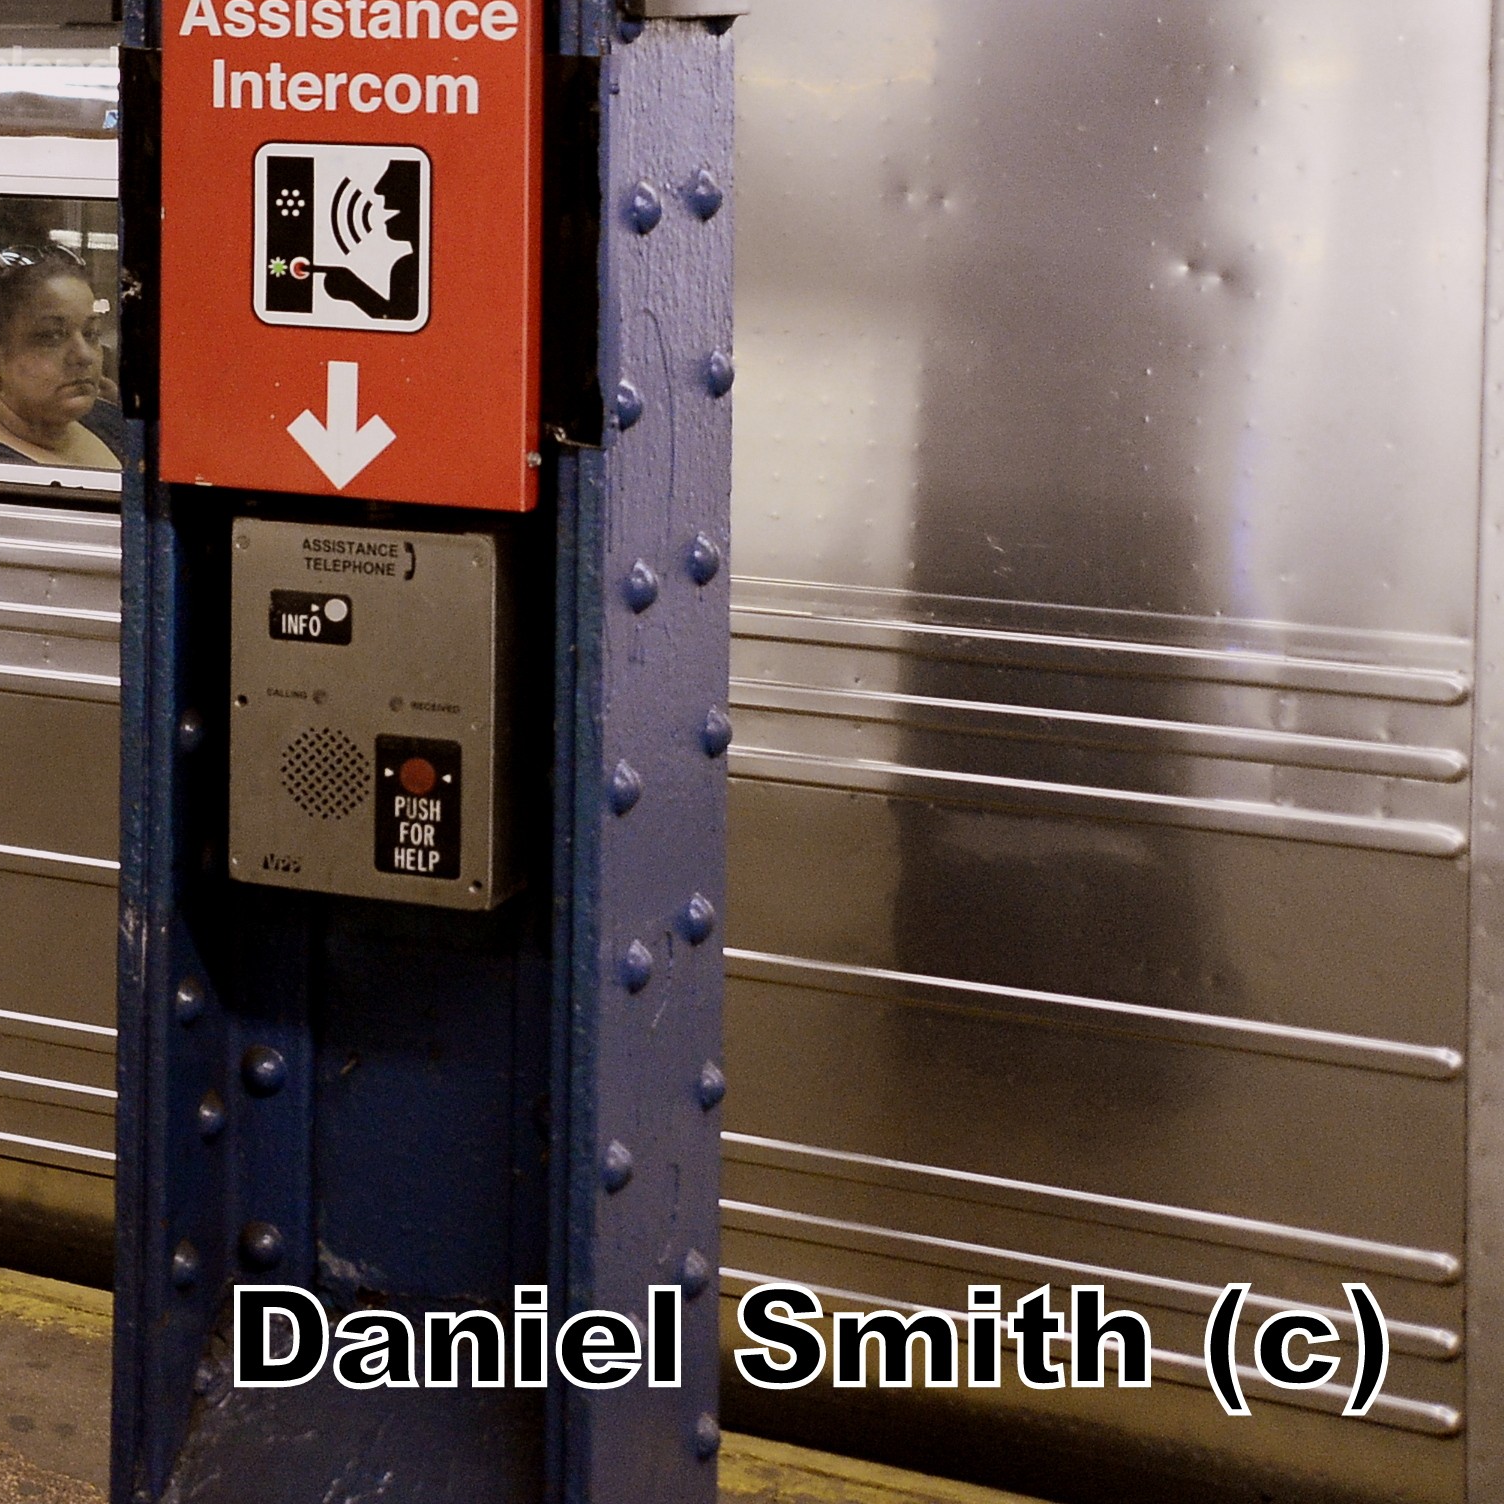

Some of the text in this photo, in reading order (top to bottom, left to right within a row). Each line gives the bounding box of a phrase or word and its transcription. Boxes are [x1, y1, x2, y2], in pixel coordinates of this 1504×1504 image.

[212, 59, 480, 115] Intercom
[302, 538, 399, 559] ASSISTANCE
[304, 557, 397, 577] TELEPHONE
[281, 613, 322, 637] INFO
[266, 687, 309, 700] CALLING
[409, 700, 462, 715] RECEIVED
[394, 796, 441, 823] PUSH
[399, 821, 435, 847] FOR
[394, 847, 440, 873] HELP
